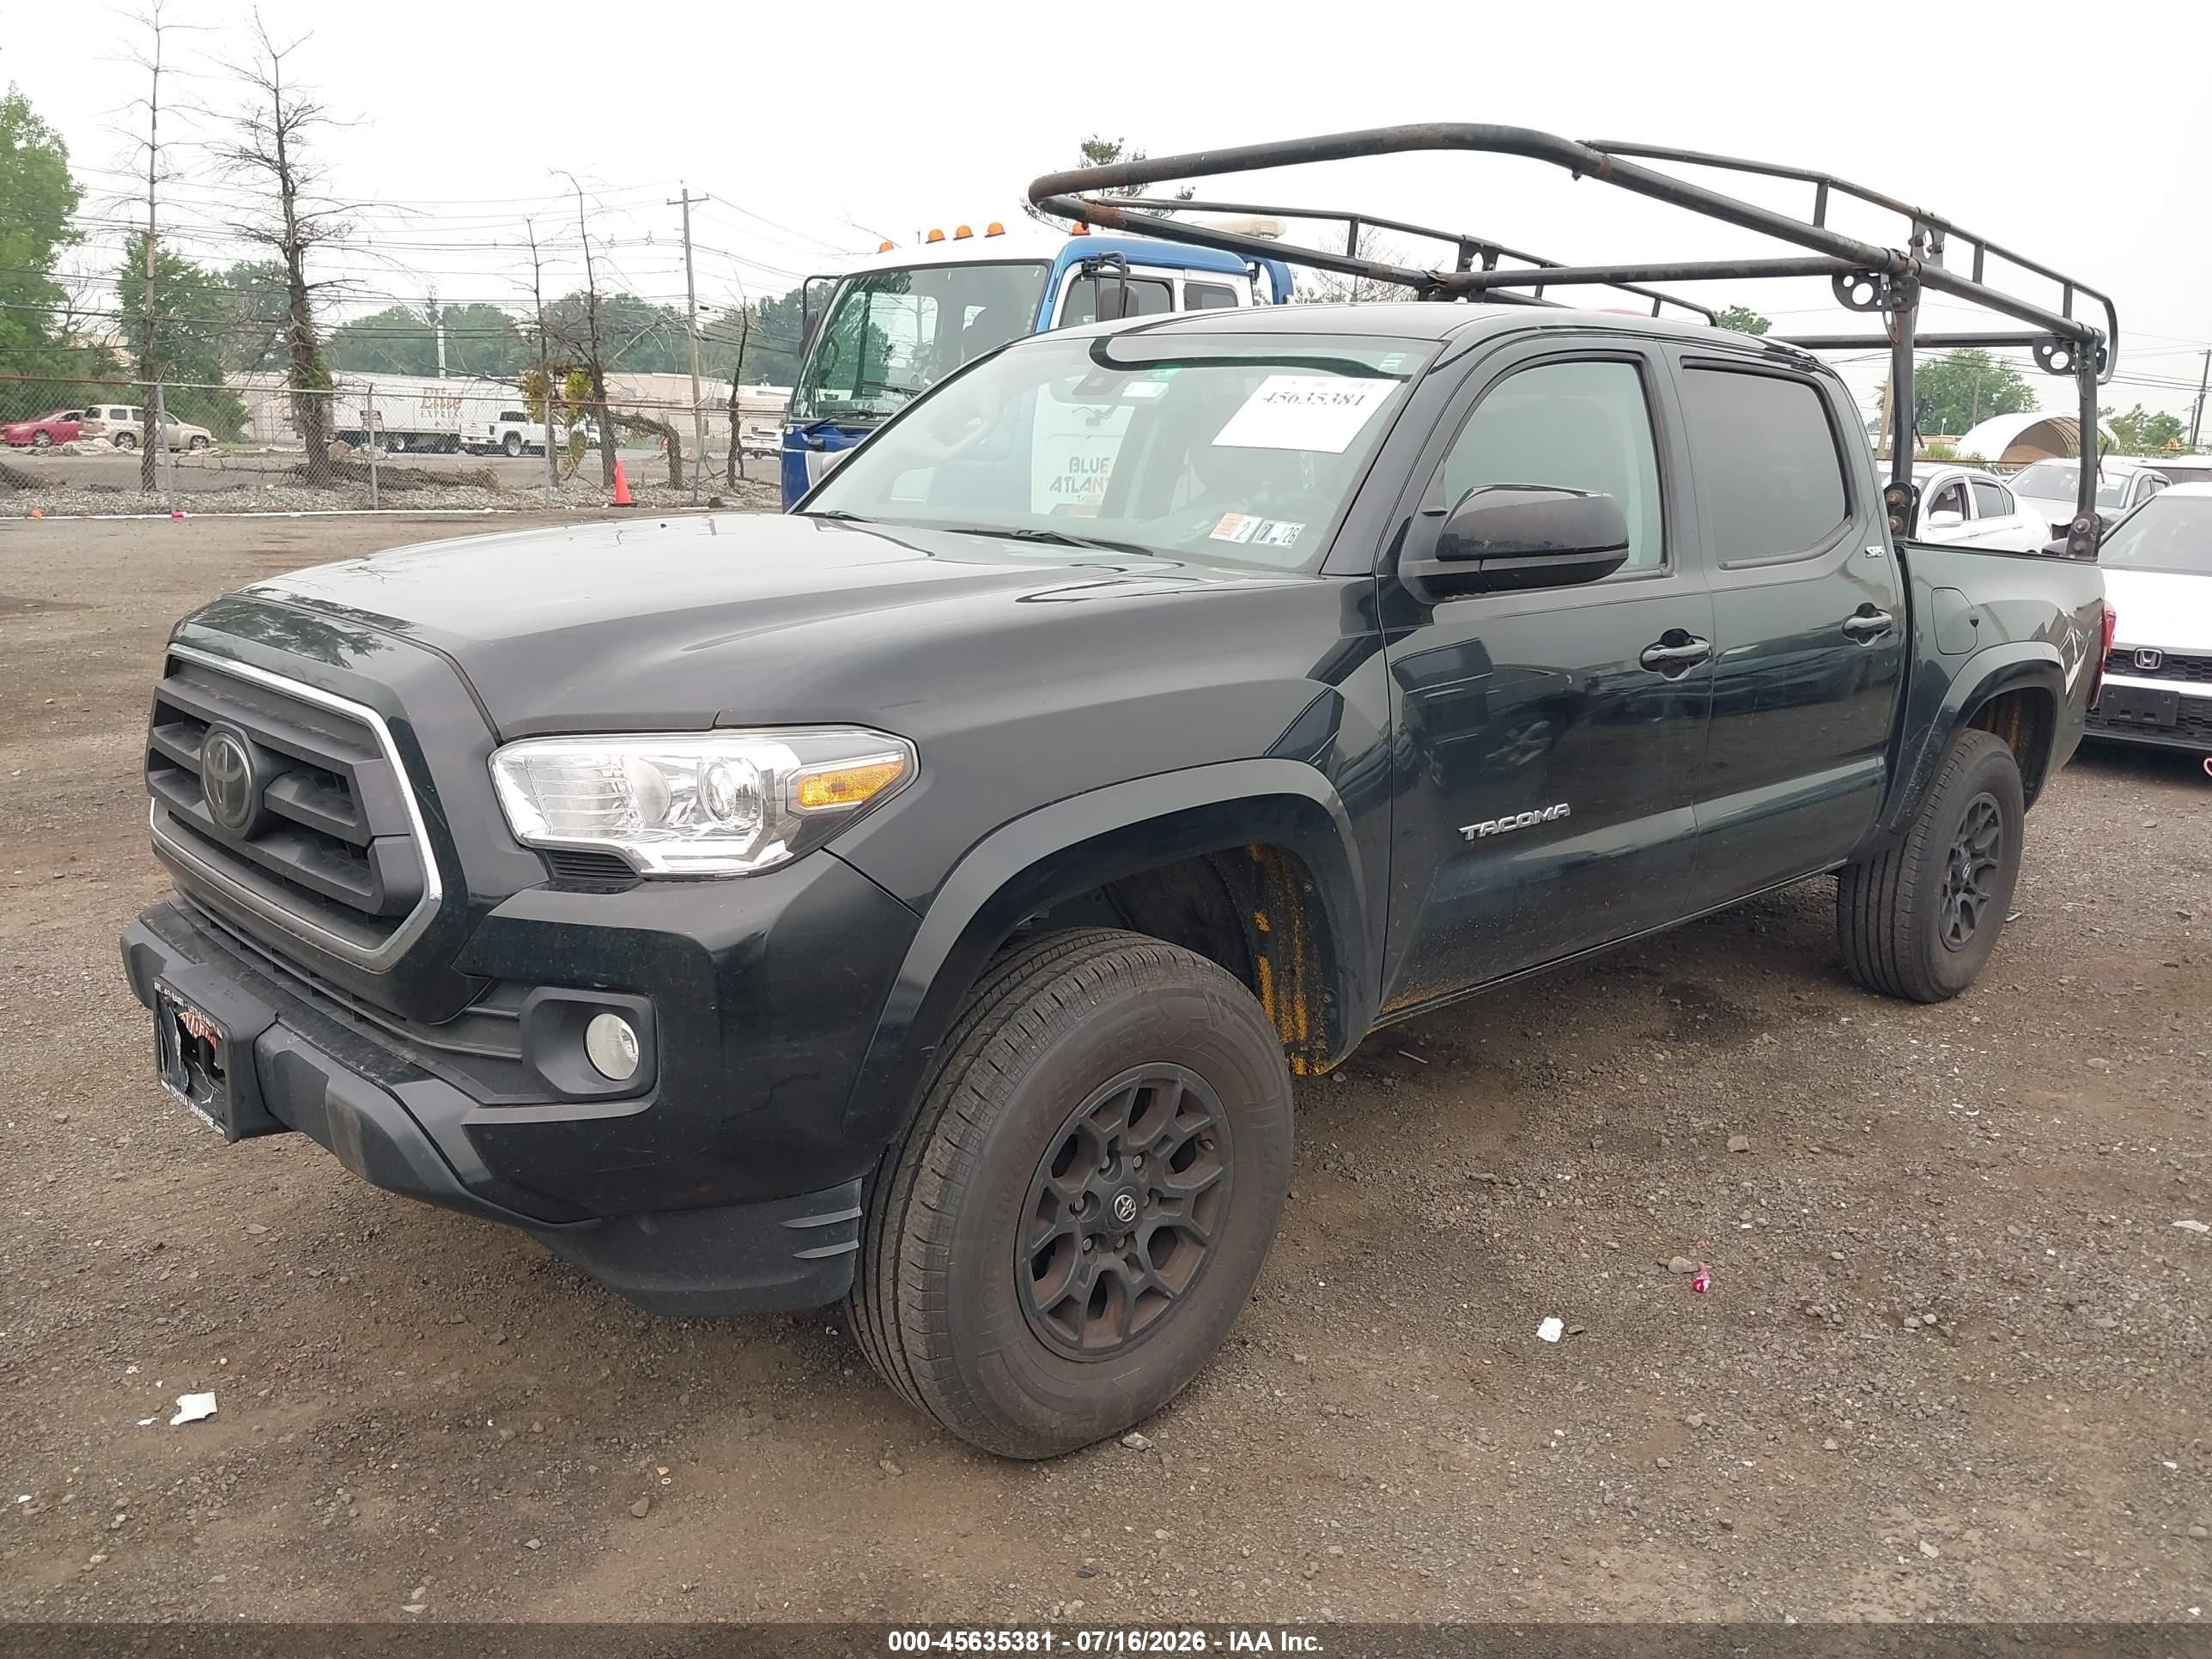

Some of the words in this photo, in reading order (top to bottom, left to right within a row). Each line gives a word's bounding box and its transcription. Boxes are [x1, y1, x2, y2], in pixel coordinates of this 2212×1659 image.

[1263, 392, 1366, 406] 45635381
[421, 410, 465, 419] EXPRESS
[1069, 456, 1111, 474] BLUE
[1049, 476, 1109, 494] ATLAN
[1458, 803, 1571, 841] TACOMA
